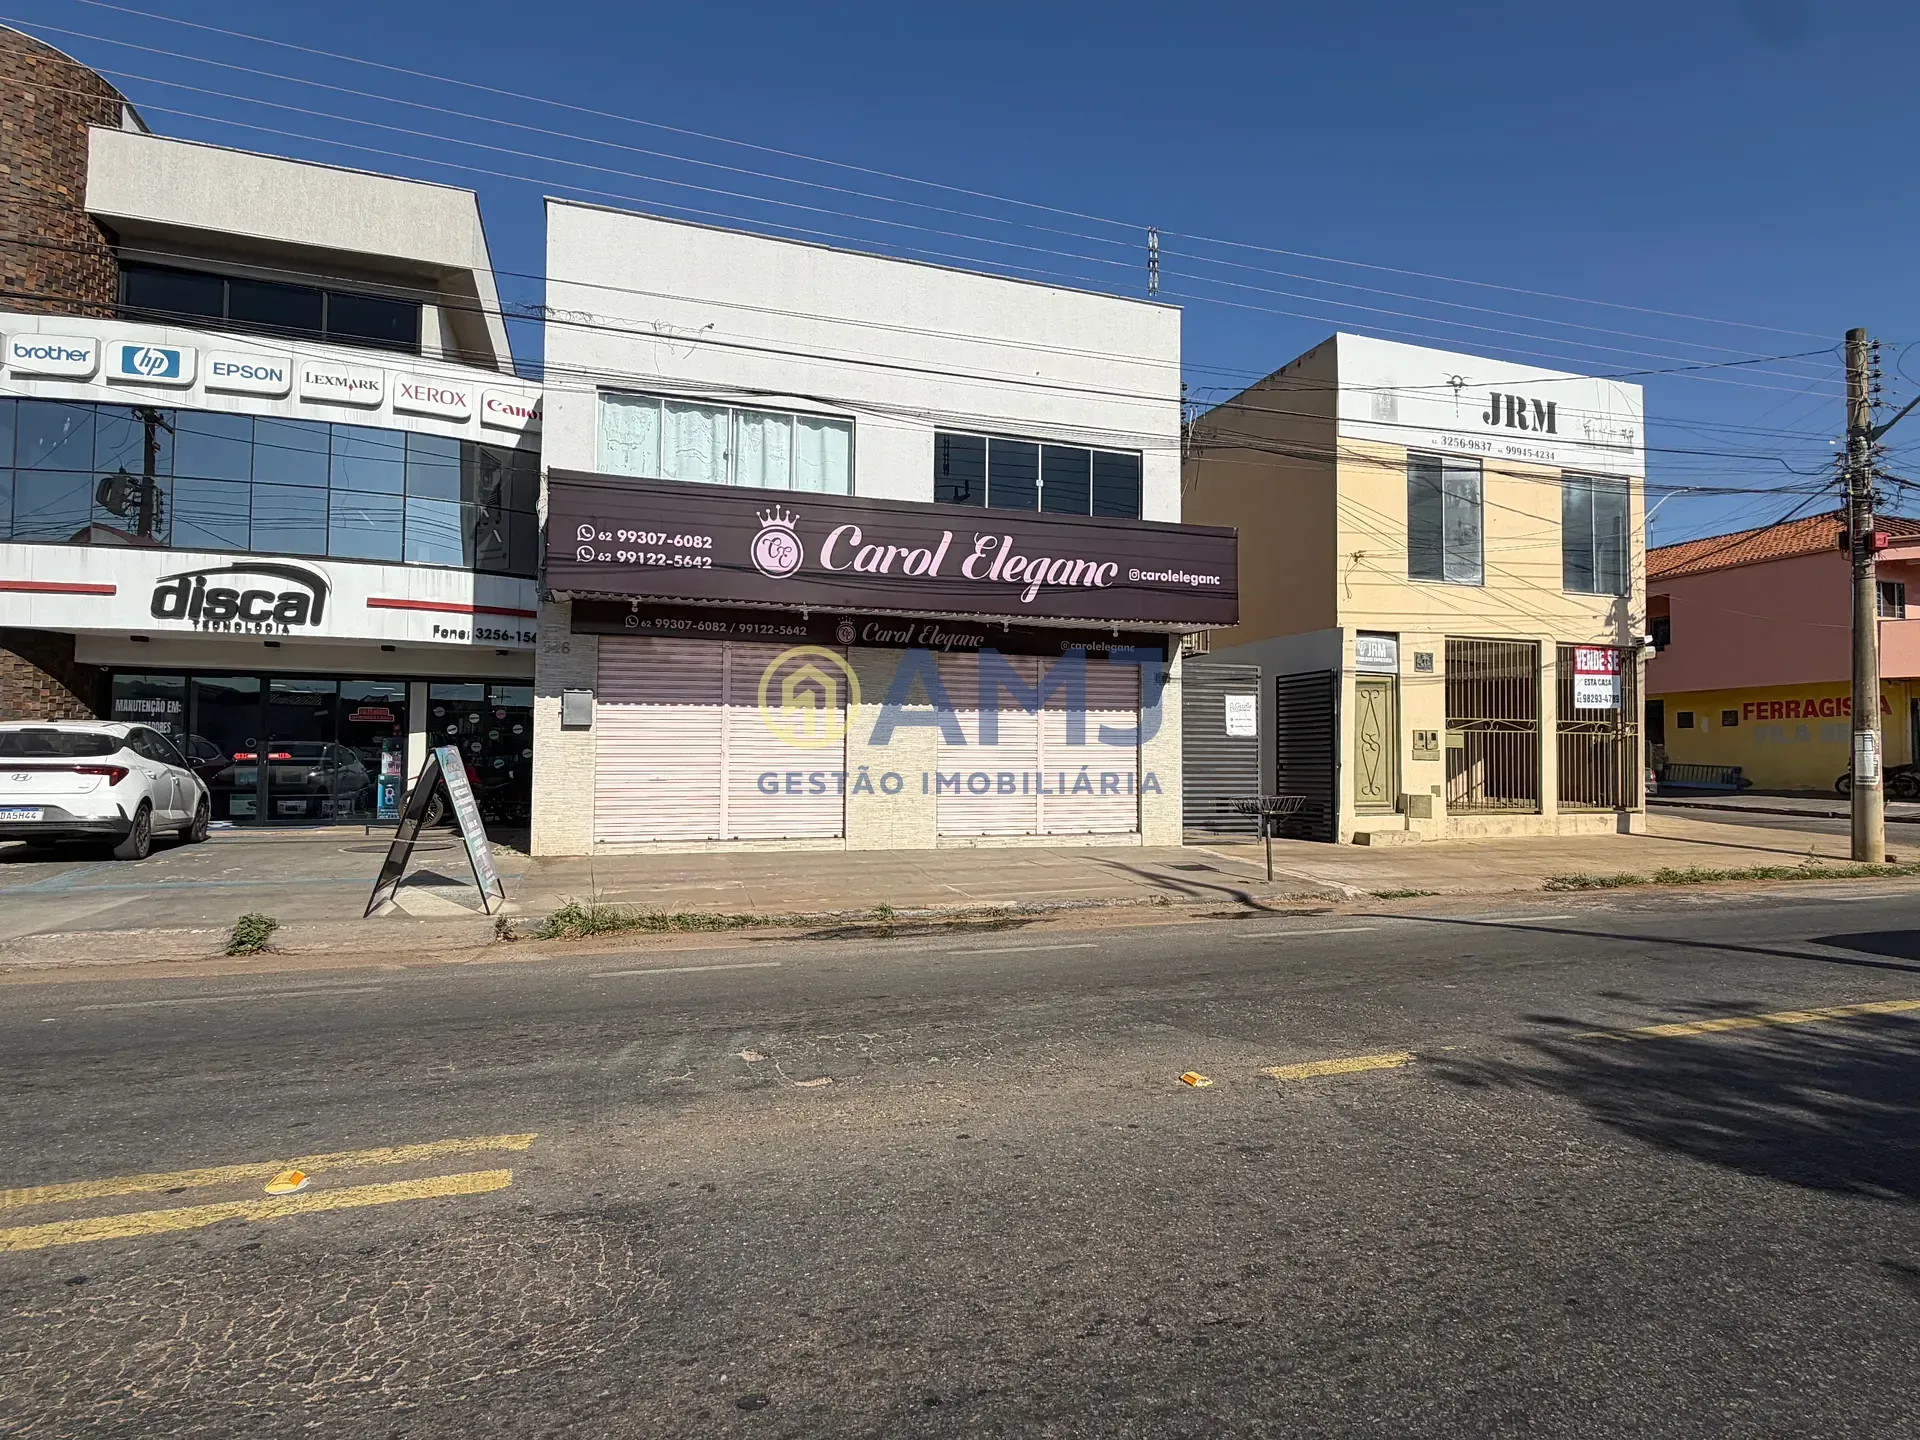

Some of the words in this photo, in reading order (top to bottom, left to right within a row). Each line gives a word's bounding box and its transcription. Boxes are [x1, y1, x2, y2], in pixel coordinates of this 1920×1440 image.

[14, 343, 91, 362] brother
[139, 348, 165, 376] hp
[213, 362, 283, 382] EPSON
[305, 371, 380, 391] LEXMARK
[401, 383, 467, 408] XEROX
[1482, 391, 1558, 434] JRM
[1441, 435, 1492, 452] 3256-9837
[598, 531, 612, 541] 62
[617, 529, 712, 549] 99307-6082
[597, 552, 612, 562] 62
[616, 550, 712, 569] 99122-5642
[820, 524, 953, 577] Carol
[961, 532, 1119, 603] Eleganc
[1140, 568, 1220, 586] caroleleganc
[151, 567, 328, 627] discal
[655, 618, 727, 632] 99307-6082
[739, 623, 807, 636] 99122-5642
[862, 622, 915, 643] Carol
[918, 624, 984, 652] Eleganc
[1367, 642, 1387, 657] JRM
[1576, 650, 1619, 671] VENDE-SE
[1584, 678, 1597, 686] ESTA
[115, 698, 166, 717] MANUTENÇÃO
[1743, 694, 1892, 720] FERRAGISA
